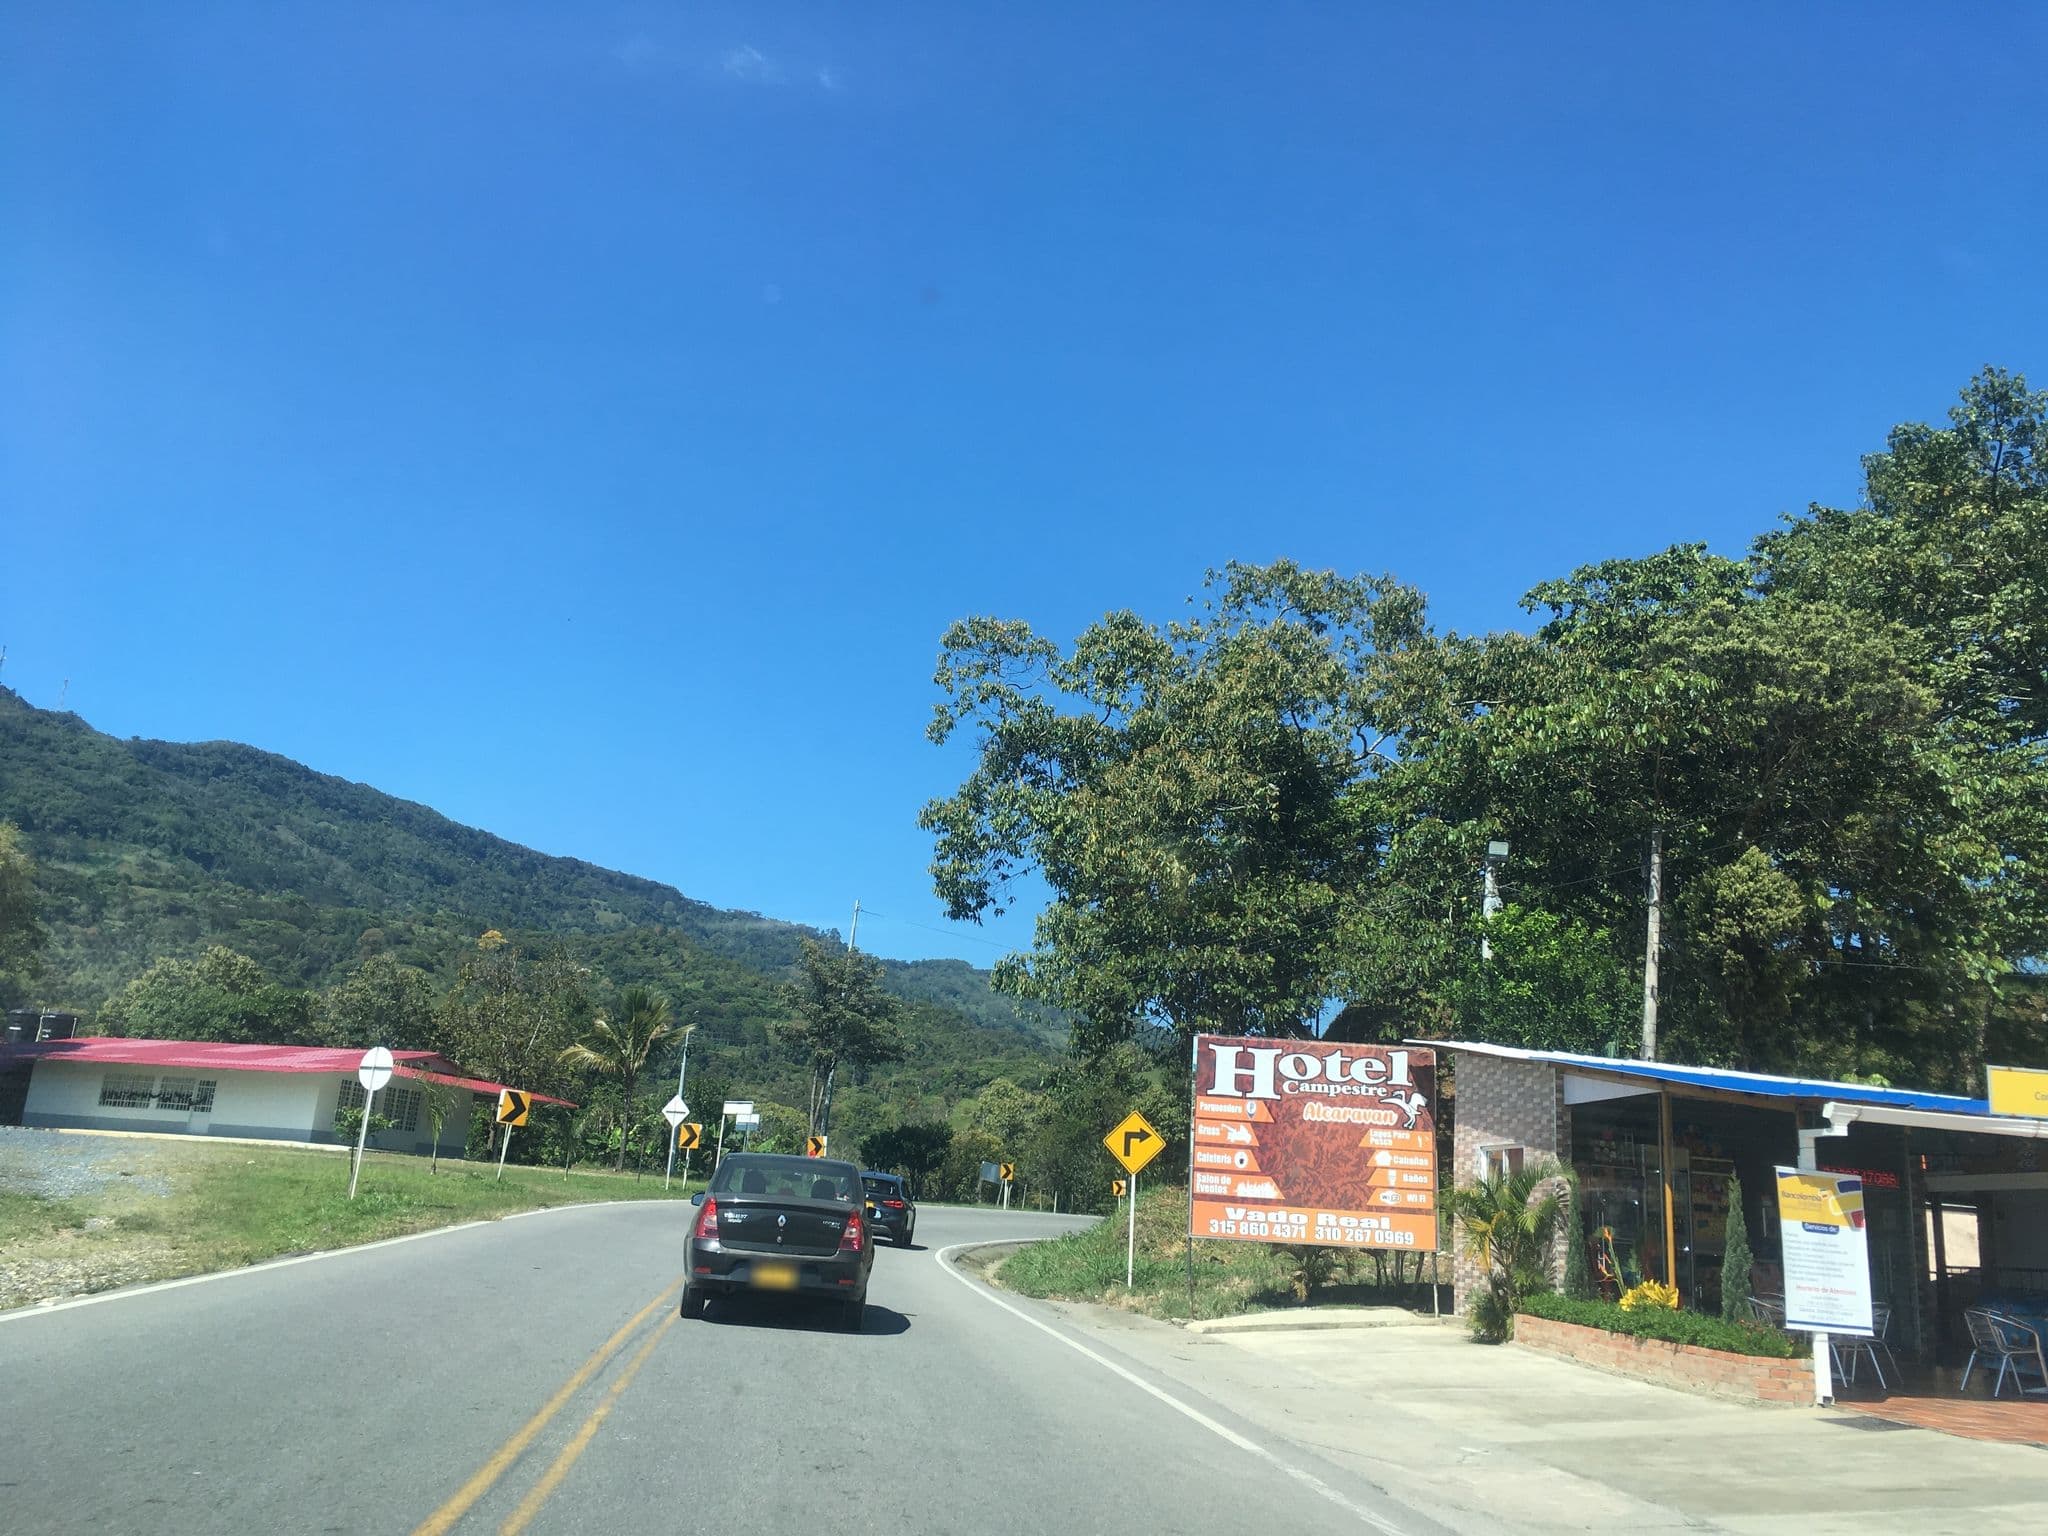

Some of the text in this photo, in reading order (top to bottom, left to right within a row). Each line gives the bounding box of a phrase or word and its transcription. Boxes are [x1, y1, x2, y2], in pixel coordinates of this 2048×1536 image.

[1207, 1043, 1413, 1100] Hotel
[1282, 1080, 1388, 1097] Campestre
[1302, 1102, 1398, 1126] Alcaravan
[1224, 1207, 1391, 1230] Vado Real
[1209, 1219, 1236, 1234] 315
[1272, 1224, 1306, 1239] 4371
[1314, 1226, 1341, 1241] 310
[1344, 1228, 1373, 1243] 267
[1374, 1230, 1414, 1245] 0969
